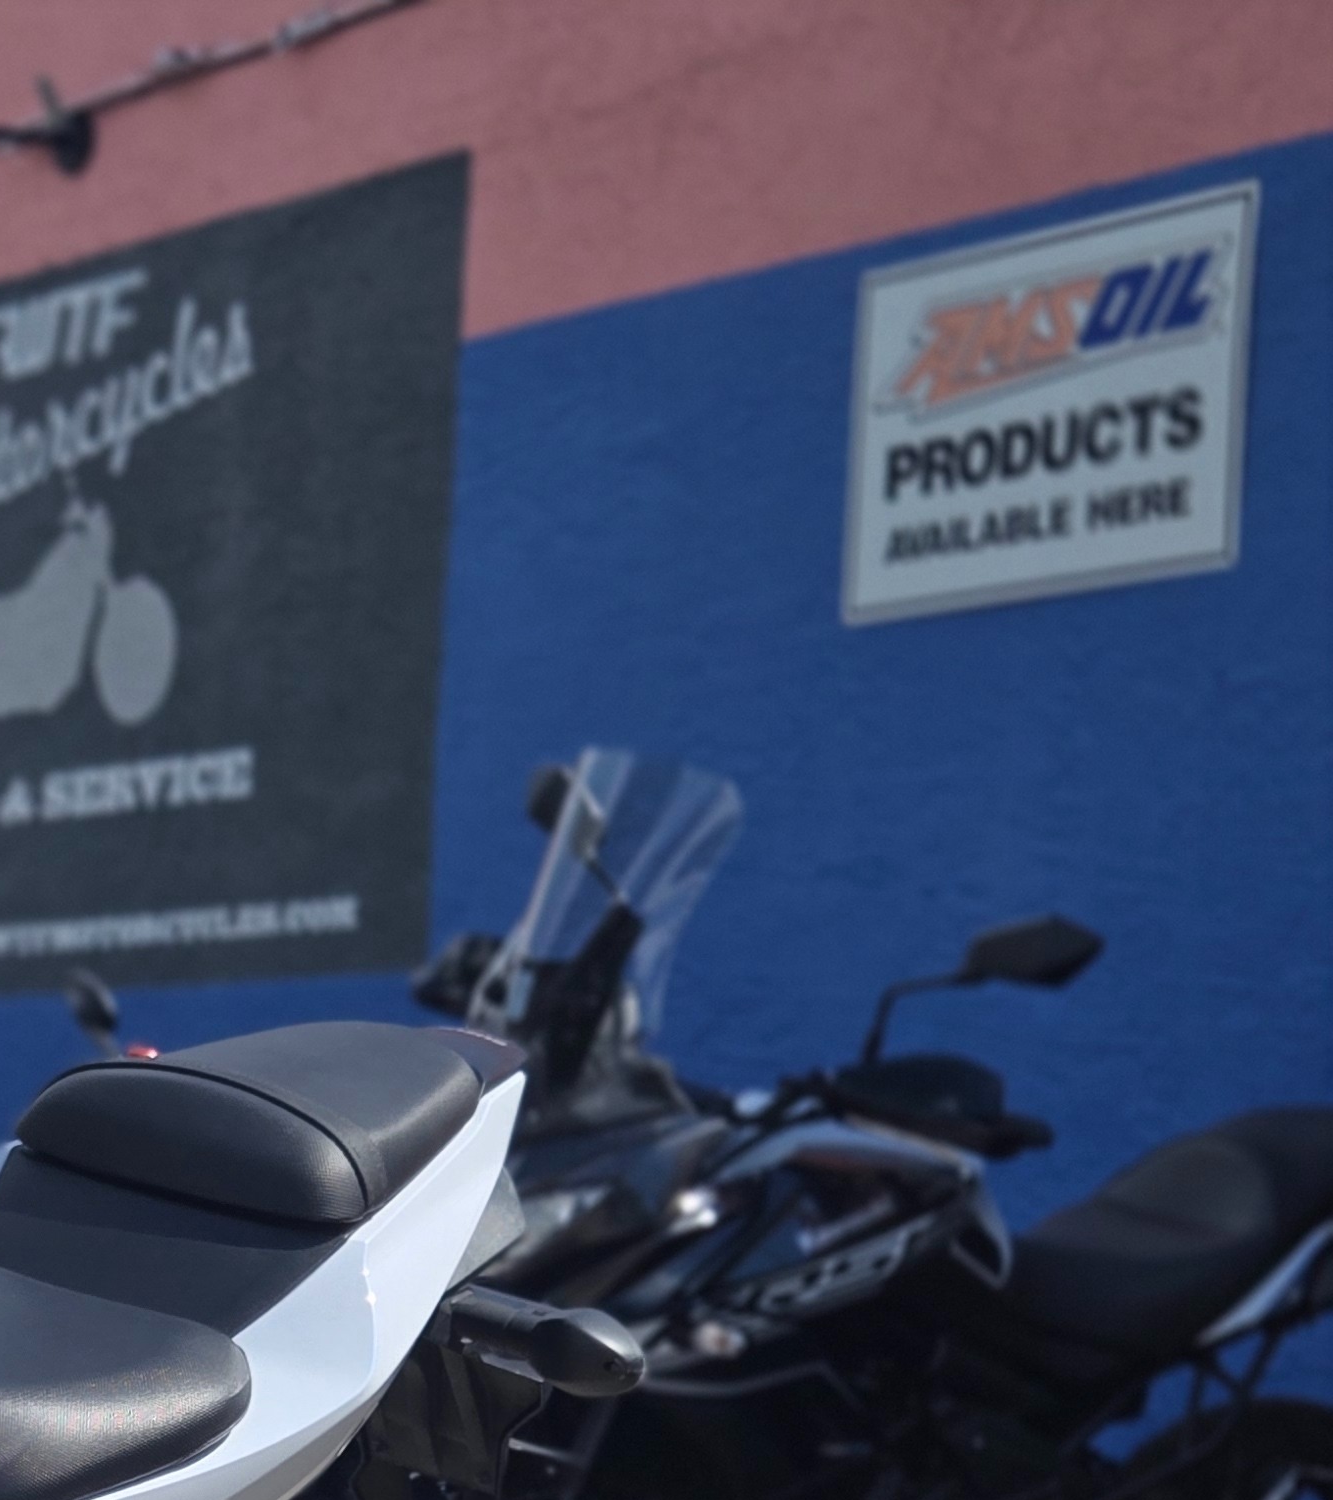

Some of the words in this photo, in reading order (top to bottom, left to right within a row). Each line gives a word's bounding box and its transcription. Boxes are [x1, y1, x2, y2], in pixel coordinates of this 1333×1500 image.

[884, 384, 1203, 503] PRODUCTS
[884, 495, 1073, 563] AVAILABLE
[1085, 477, 1192, 532] HERE
[41, 746, 254, 822] SERVICE
